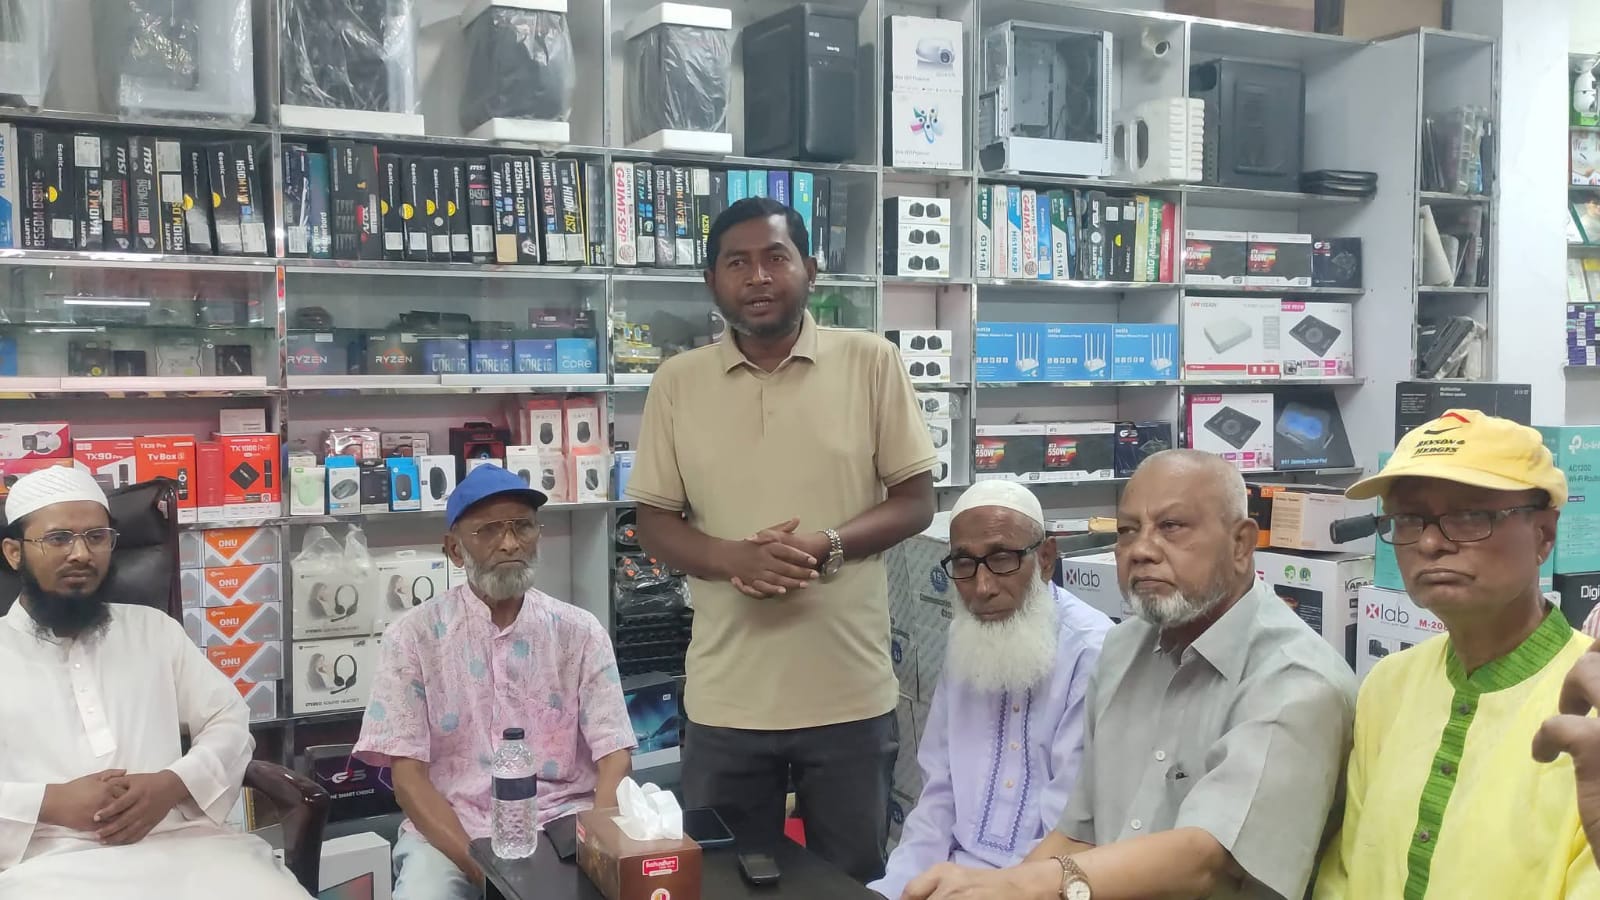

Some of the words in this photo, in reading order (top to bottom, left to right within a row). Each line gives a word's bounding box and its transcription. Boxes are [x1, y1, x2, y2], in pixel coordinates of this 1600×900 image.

[116, 146, 127, 175] msi
[143, 146, 153, 175] msi
[504, 162, 512, 194] GIGABYTE
[172, 217, 184, 250] H310M
[288, 356, 328, 364] RYZEN
[376, 356, 412, 364] RYZEN
[218, 539, 238, 547] ONU
[219, 578, 238, 586] ONU
[220, 618, 240, 626] ONU
[221, 658, 241, 666] ONU
